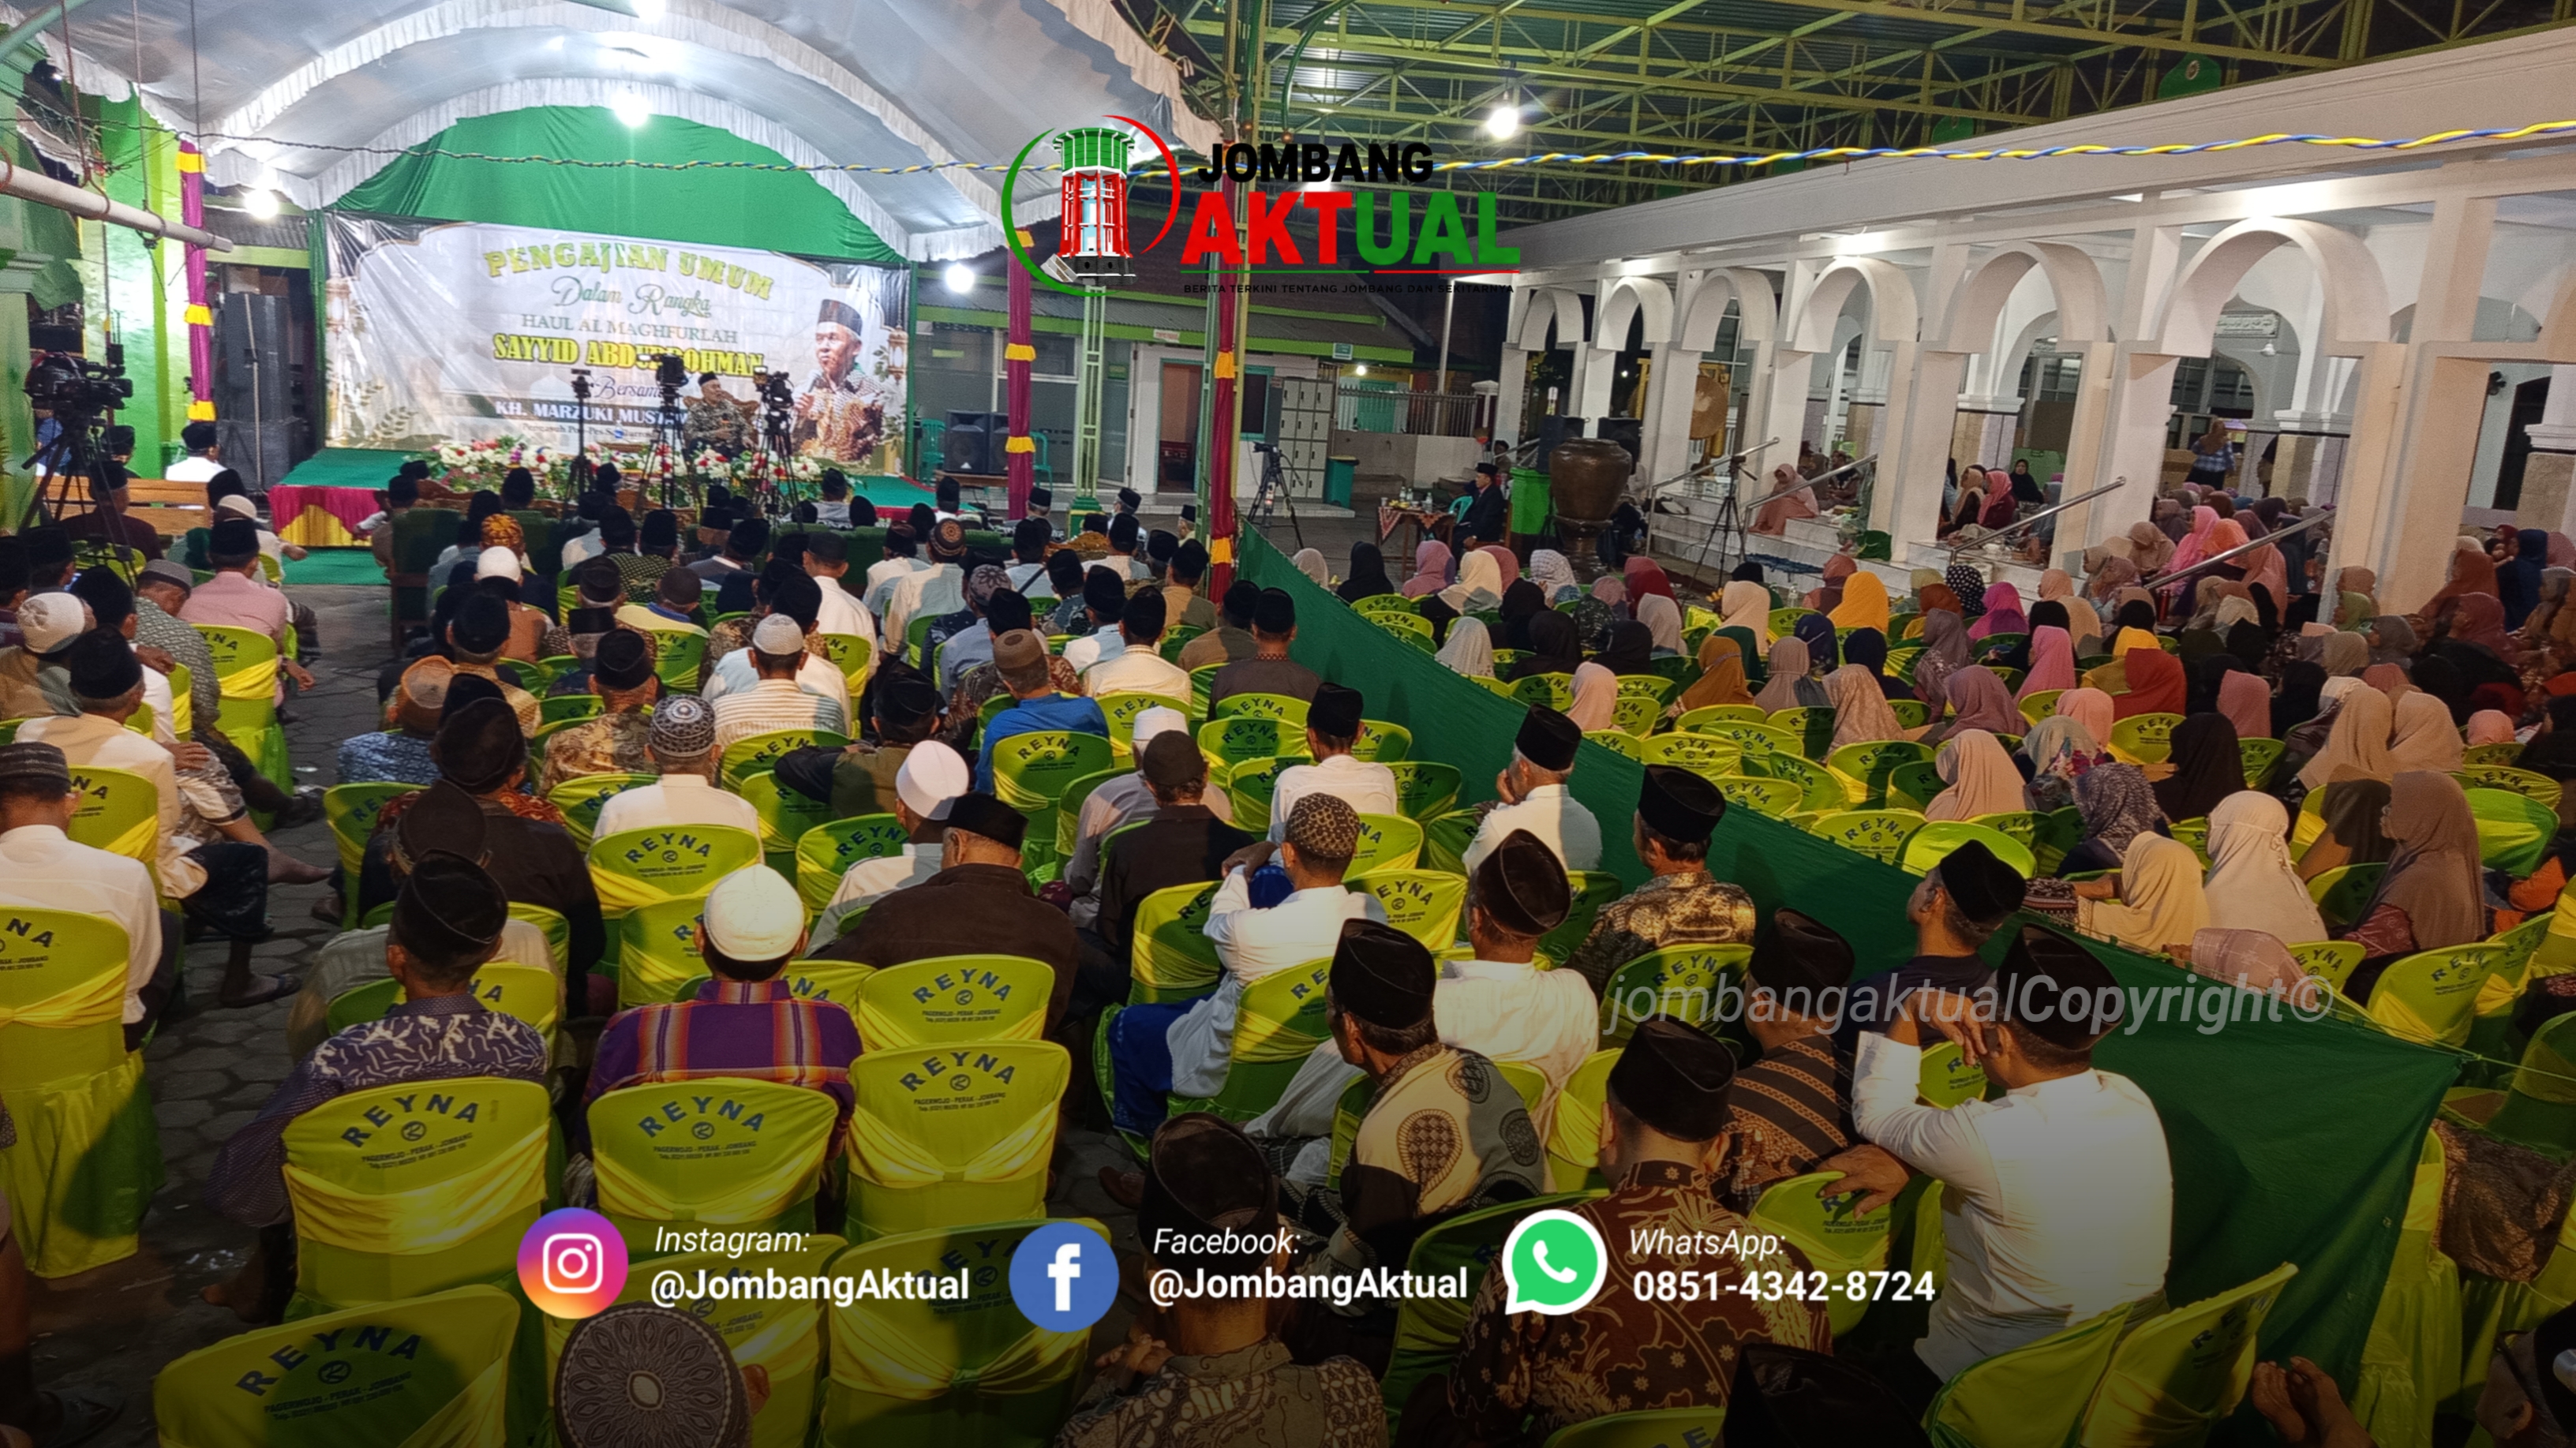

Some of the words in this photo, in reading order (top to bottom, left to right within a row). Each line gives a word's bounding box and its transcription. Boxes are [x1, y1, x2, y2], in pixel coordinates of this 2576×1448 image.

[483, 241, 669, 278] PENGAJIAN
[678, 251, 775, 301] UMUM
[551, 275, 623, 307] Dalam
[627, 282, 713, 318] Rangka
[522, 313, 575, 331] HAUL
[578, 318, 603, 333] AL
[606, 320, 739, 344] MAGHFURLAH
[492, 333, 579, 364] SAYYID
[593, 375, 663, 400] Bersam
[496, 401, 527, 417] KH.
[534, 402, 613, 422] MARZUKI
[657, 632, 688, 650] YNA
[1619, 702, 1643, 717] YNA
[1221, 722, 1279, 745] REYNA
[2137, 717, 2174, 734] REYN
[754, 736, 816, 763] REYN
[1017, 735, 1080, 760] REYNA
[1662, 738, 1717, 758] REYNA
[1732, 729, 1775, 750] EYNA
[1724, 782, 1772, 805] EYNA
[1844, 818, 1906, 842] REYNA
[624, 832, 712, 864] REYNA
[1376, 880, 1435, 906] EYNA
[1653, 954, 1719, 986] REYN
[912, 968, 1012, 1005] REYNA
[899, 1051, 1015, 1092] REYNA
[340, 1093, 479, 1148] REYNA
[638, 1096, 765, 1138] REYNA
[234, 1325, 422, 1397] REYNA
